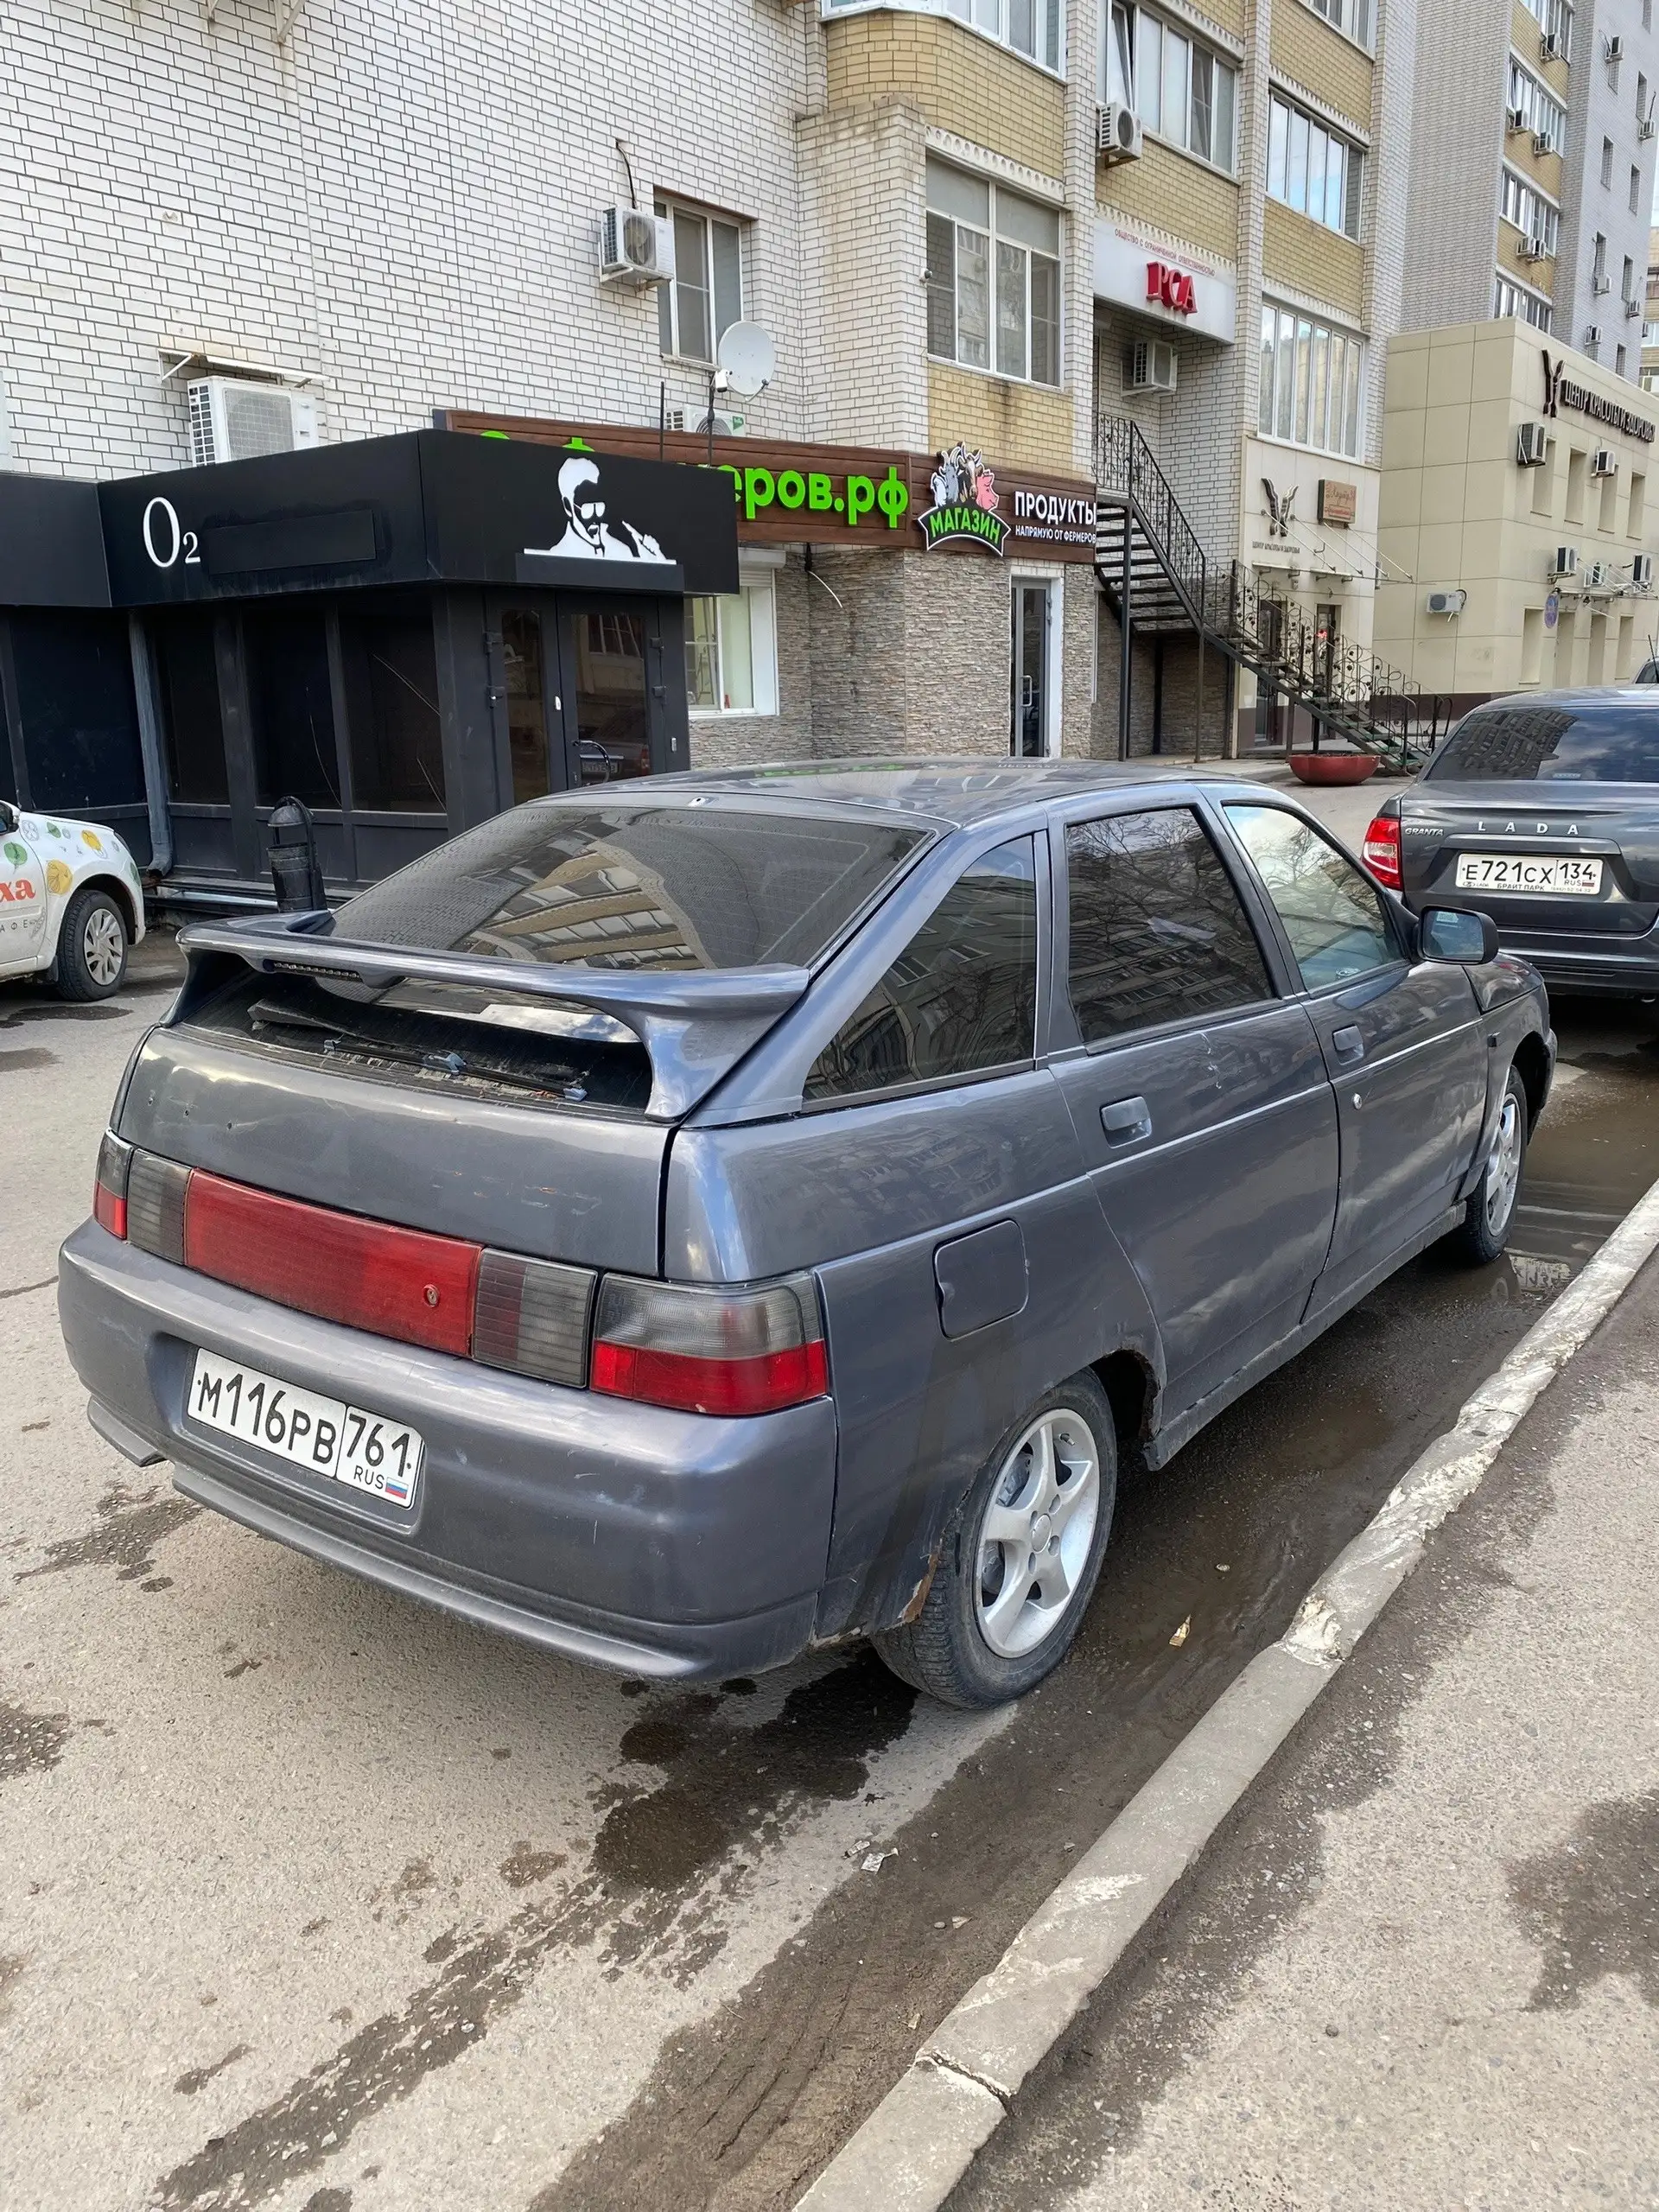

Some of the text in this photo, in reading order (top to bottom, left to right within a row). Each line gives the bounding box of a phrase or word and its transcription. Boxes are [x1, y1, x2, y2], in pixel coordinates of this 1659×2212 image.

[1146, 261, 1198, 315] РСА
[1014, 490, 1097, 526] ПРОДУКТЫ
[929, 506, 1002, 545] МАГАЗИН
[1015, 524, 1096, 543] НАПРЯМУЮ ОТ ФЕРМЕРОВ
[1405, 827, 1445, 836] GRANTA
[1478, 821, 1579, 836] LADA
[1465, 860, 1594, 885] Е721СХ 134
[198, 1371, 410, 1478] М116РВ 761
[353, 1465, 385, 1491] RUS
